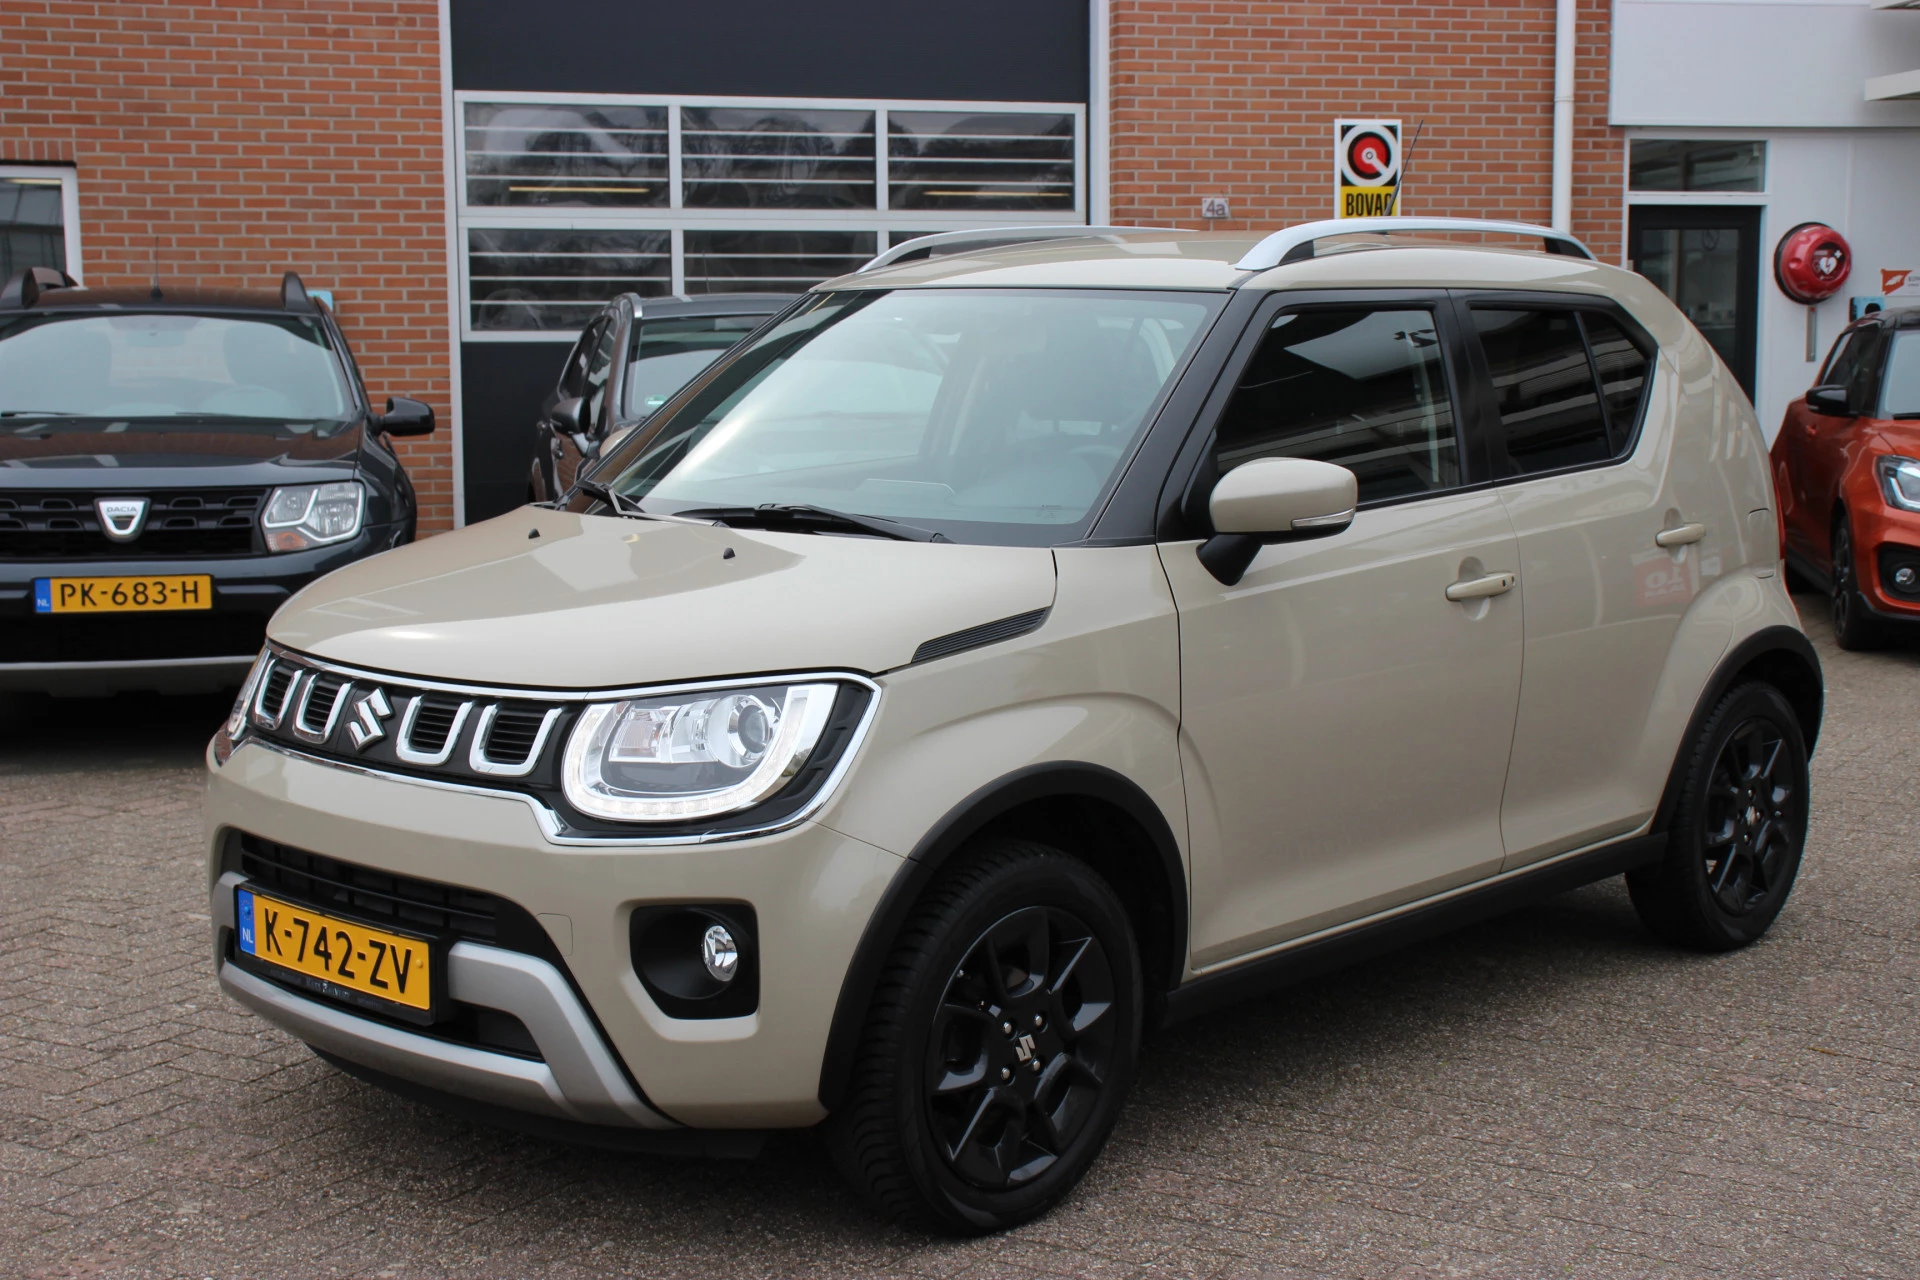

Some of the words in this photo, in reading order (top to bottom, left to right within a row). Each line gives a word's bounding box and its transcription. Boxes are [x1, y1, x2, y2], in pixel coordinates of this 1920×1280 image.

[1206, 200, 1226, 216] 4a
[37, 598, 49, 607] NL
[60, 580, 198, 607] PK-683-H
[242, 926, 254, 944] NL
[264, 907, 412, 994] K-742-ZV
